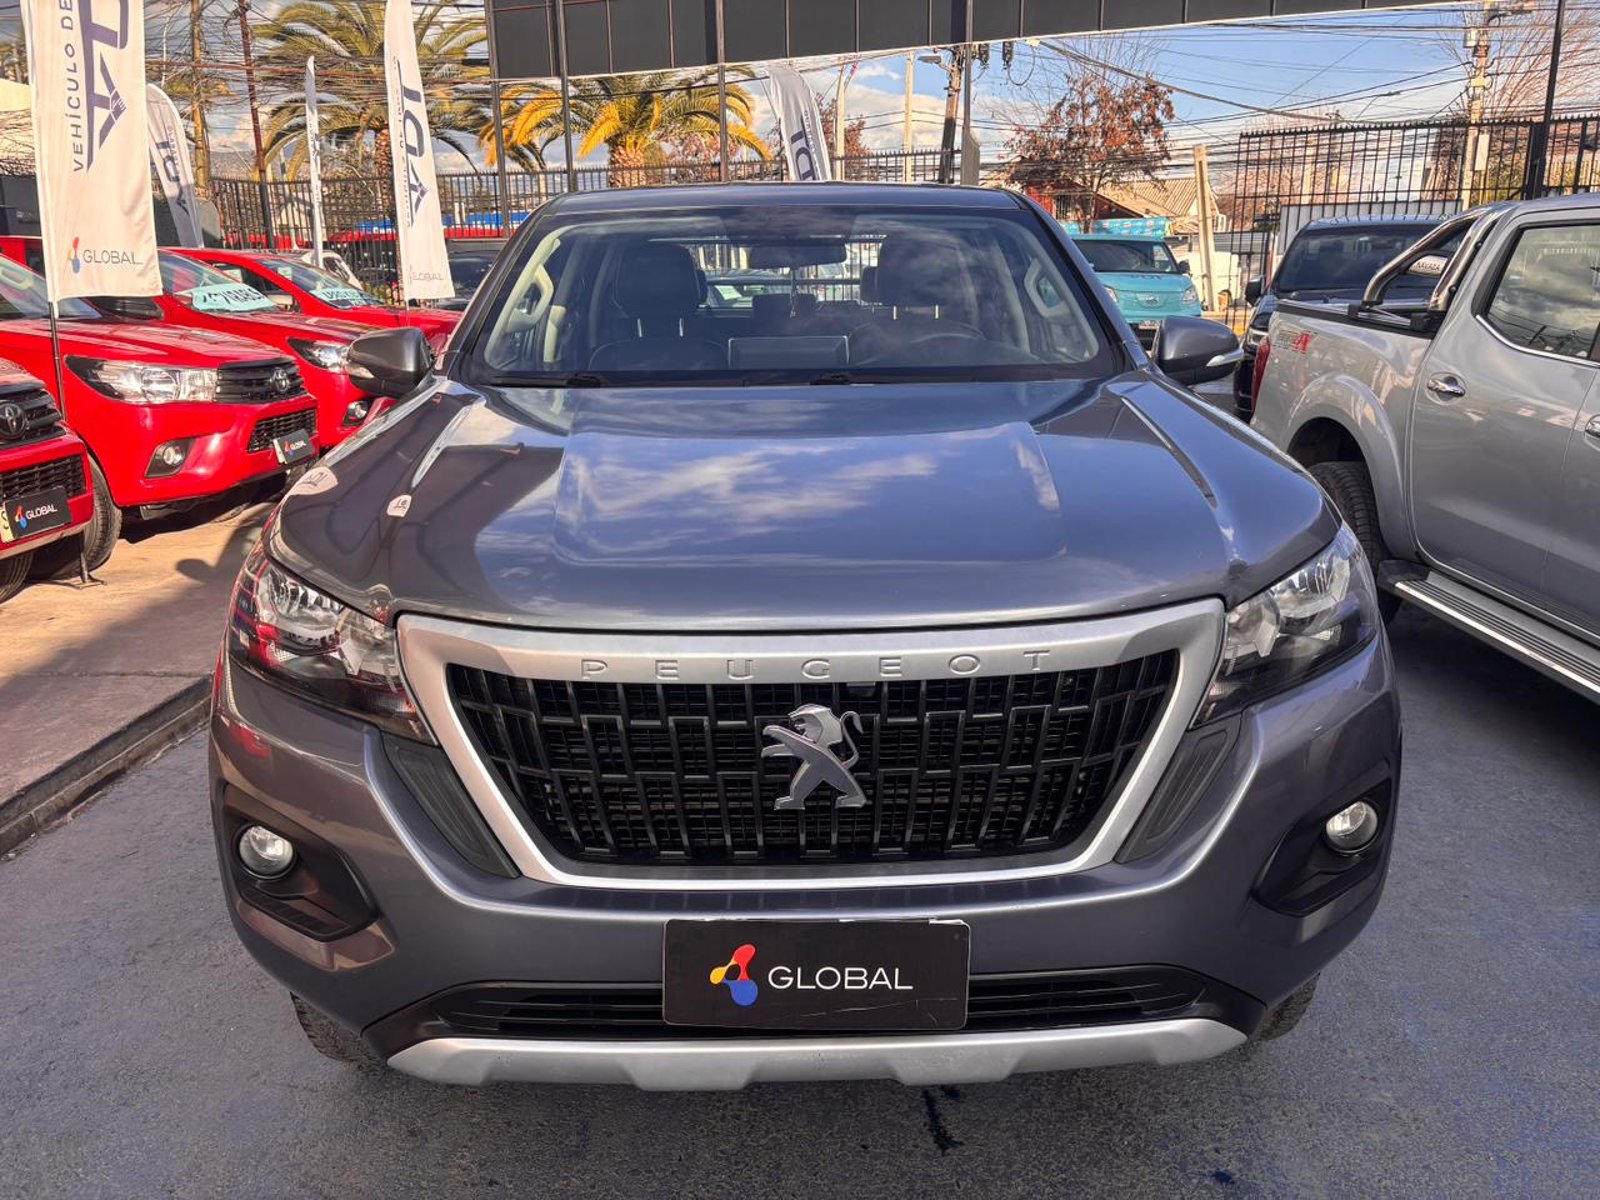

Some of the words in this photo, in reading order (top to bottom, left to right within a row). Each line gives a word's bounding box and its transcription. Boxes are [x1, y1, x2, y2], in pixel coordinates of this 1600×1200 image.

[59, 0, 75, 31] DE
[64, 43, 85, 172] VEHÍCULO
[83, 249, 144, 264] GLOBAL
[25, 504, 58, 520] GLOBAL
[580, 649, 1051, 681] PEUGEOT
[768, 965, 914, 990] GLOBAL
